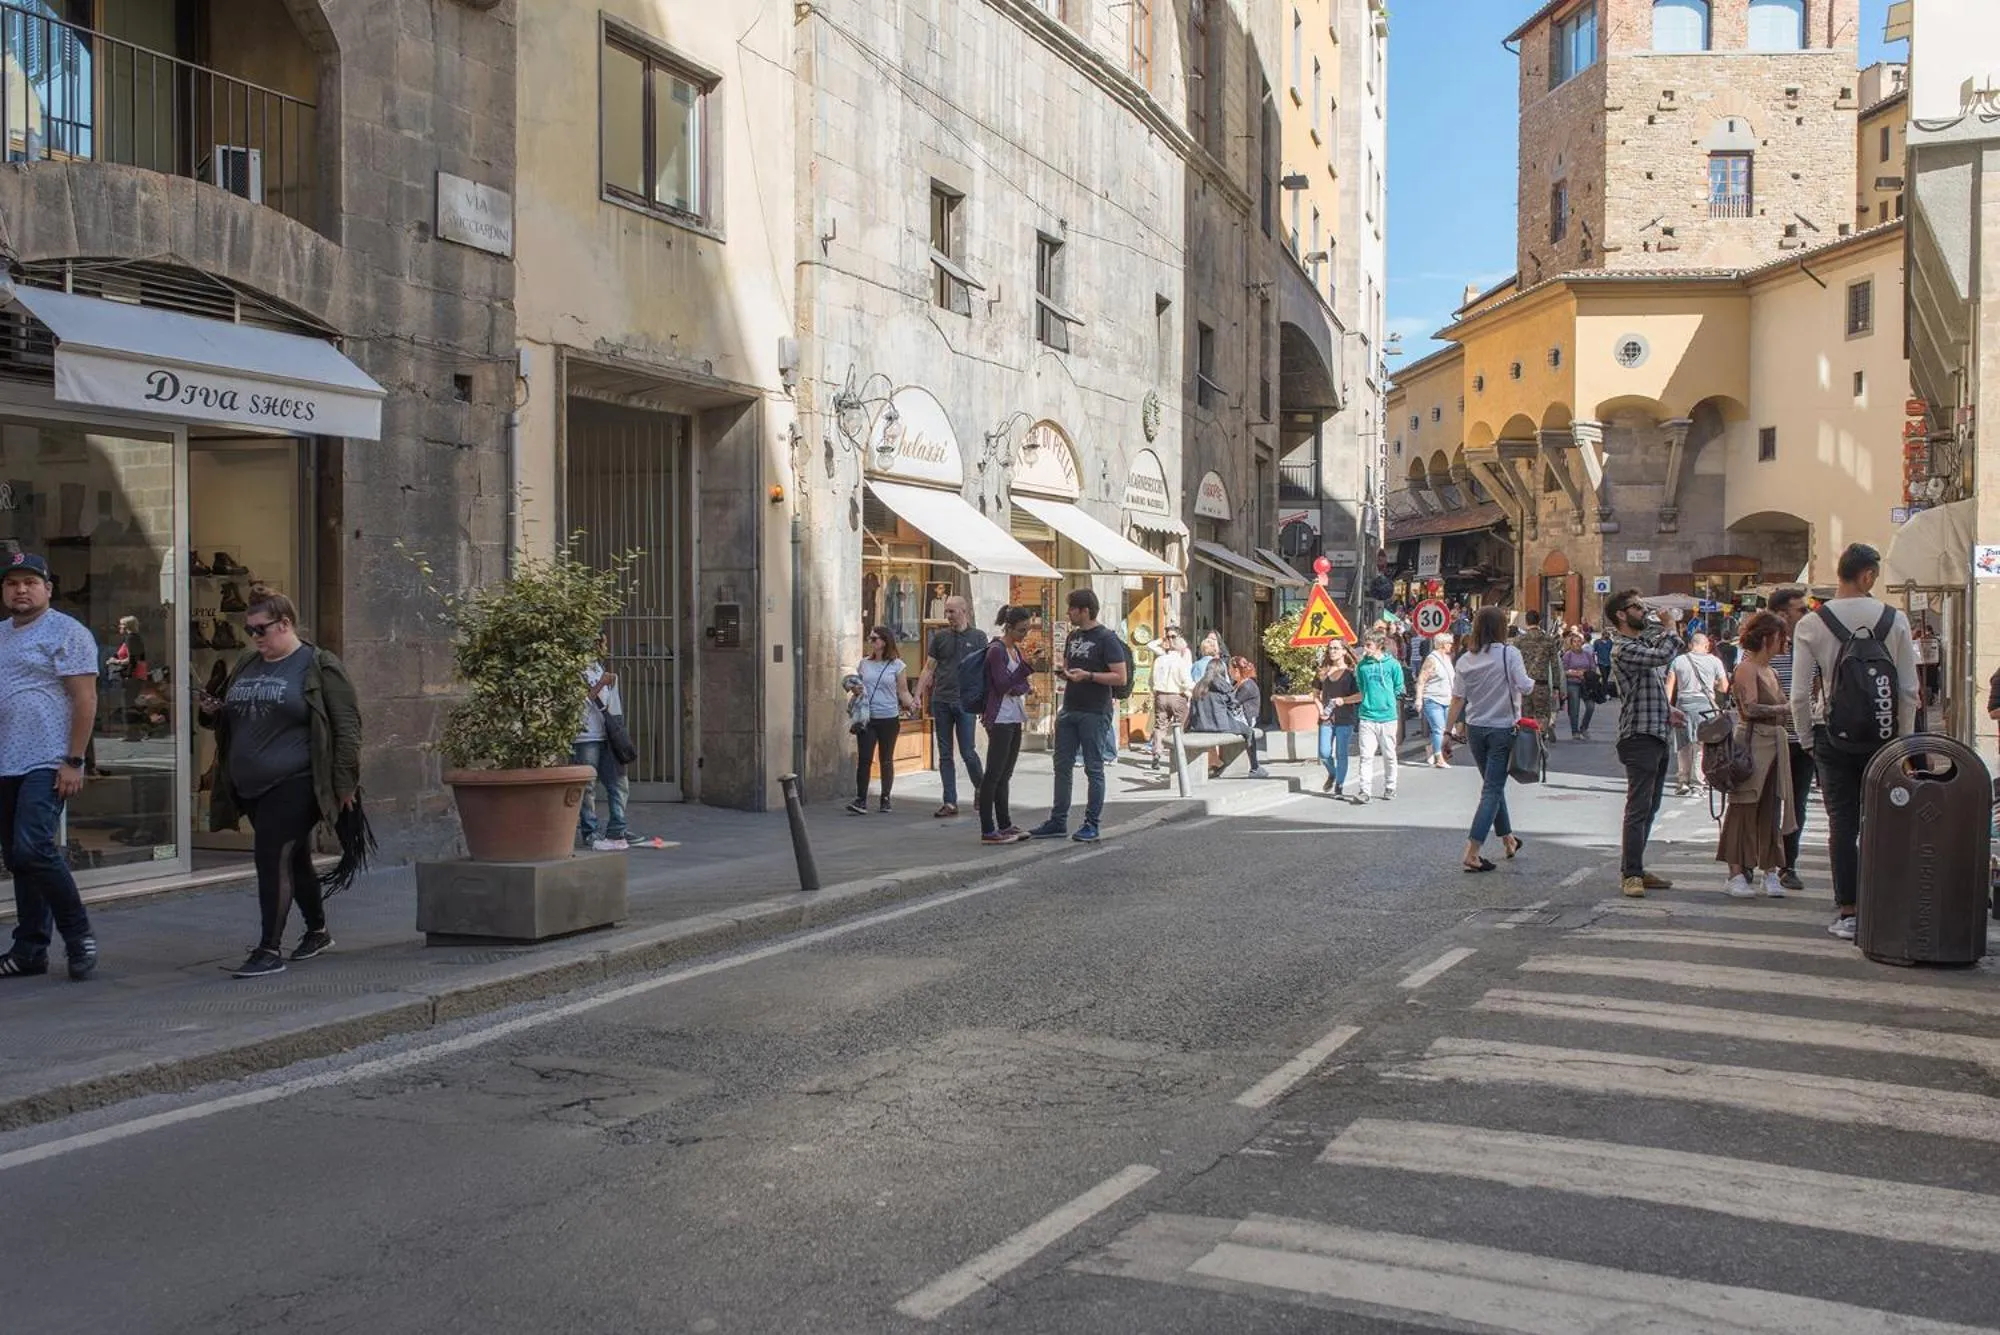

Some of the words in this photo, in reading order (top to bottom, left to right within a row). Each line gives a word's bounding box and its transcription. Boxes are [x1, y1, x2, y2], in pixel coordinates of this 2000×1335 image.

[465, 191, 488, 214] VIA
[249, 394, 316, 421] SHOES
[1420, 610, 1443, 628] 30
[1874, 675, 1893, 740] adidas
